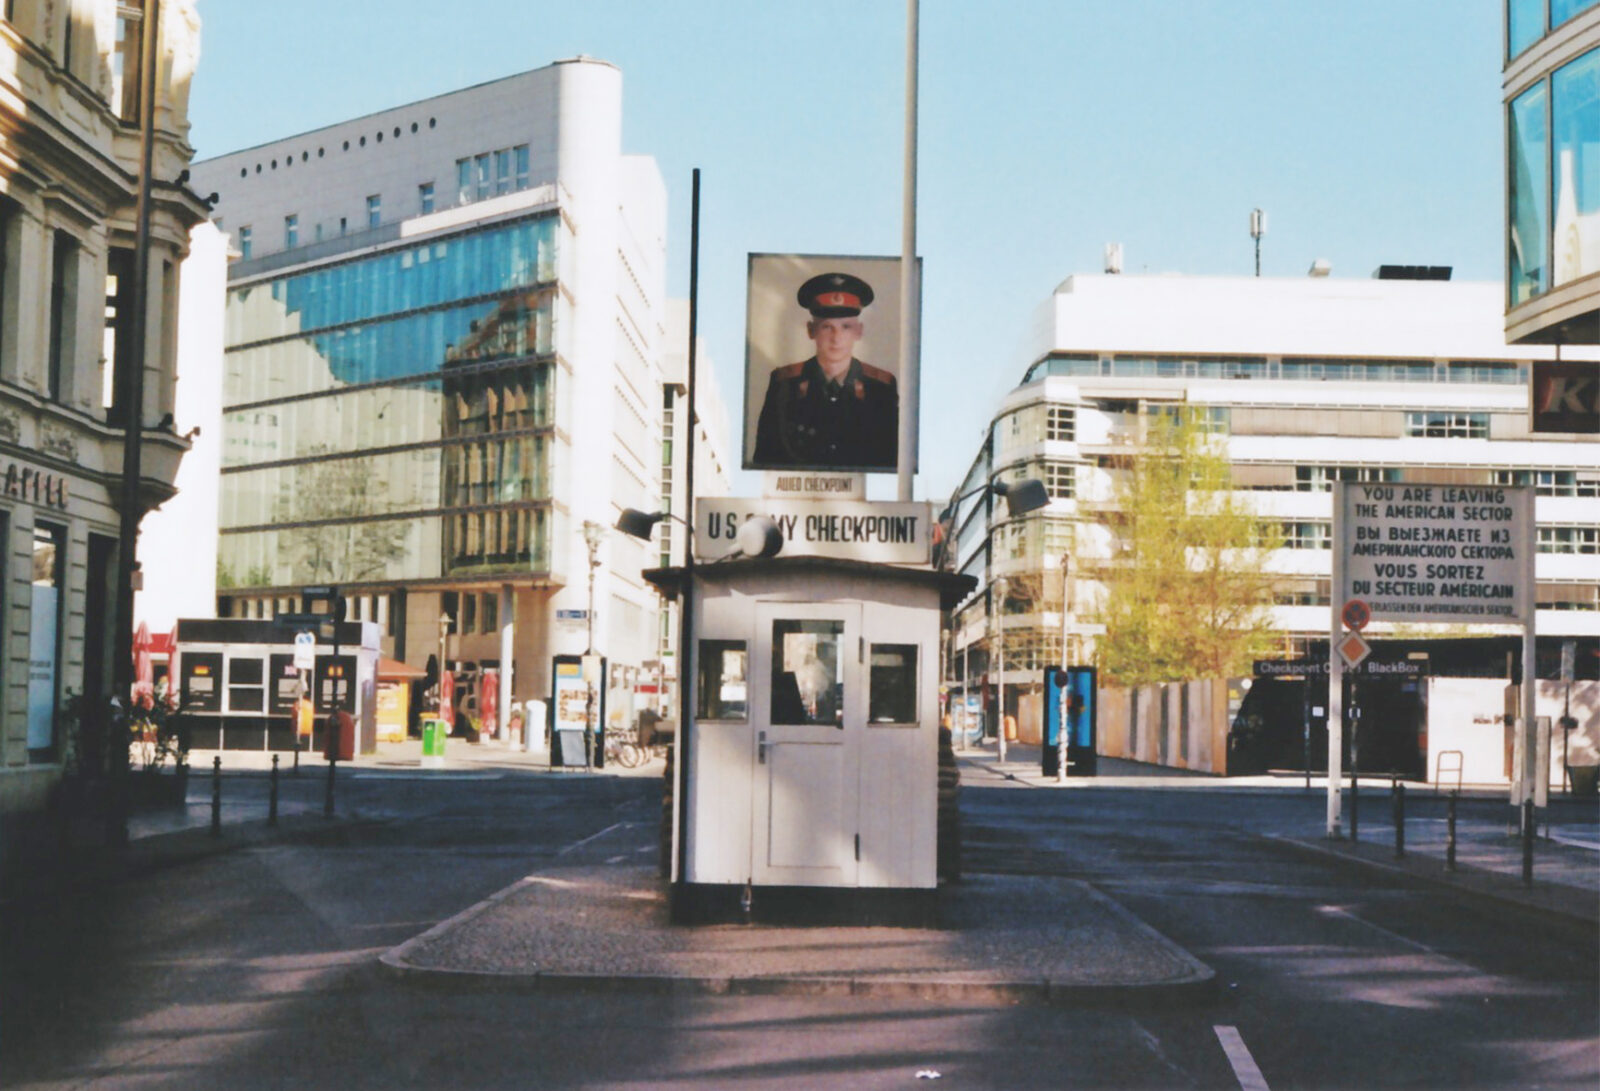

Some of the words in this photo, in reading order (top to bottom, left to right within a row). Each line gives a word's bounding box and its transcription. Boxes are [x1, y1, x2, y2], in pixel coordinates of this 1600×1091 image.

[1540, 376, 1600, 414] K
[776, 477, 801, 491] ALLIED
[804, 477, 853, 492] CHECKPOINT
[1363, 487, 1394, 501] YOU
[1402, 488, 1432, 502] ARE
[1442, 488, 1505, 504] LEAVING
[1355, 503, 1378, 518] THE
[1385, 504, 1455, 520] AMERICAN
[1463, 506, 1513, 521] SECTOR
[806, 514, 919, 543] CHECKPOINT
[1356, 526, 1380, 540] ВЫ
[1389, 526, 1481, 543] ВЫЕЗЖАЕТЕ
[1490, 529, 1510, 544] ИЗ
[1352, 543, 1456, 558] АМЕРИКАНСКОГО
[1461, 545, 1514, 560] СЕКТОРА
[1374, 563, 1417, 579] VOUS
[1426, 564, 1485, 580] SORTEZ
[1353, 580, 1371, 595] DU
[1375, 581, 1435, 596] SECTEUR
[1440, 581, 1514, 598] AMÉRICAIN
[1369, 602, 1406, 613] ERLASSEN
[1367, 661, 1419, 673] BlackBox
